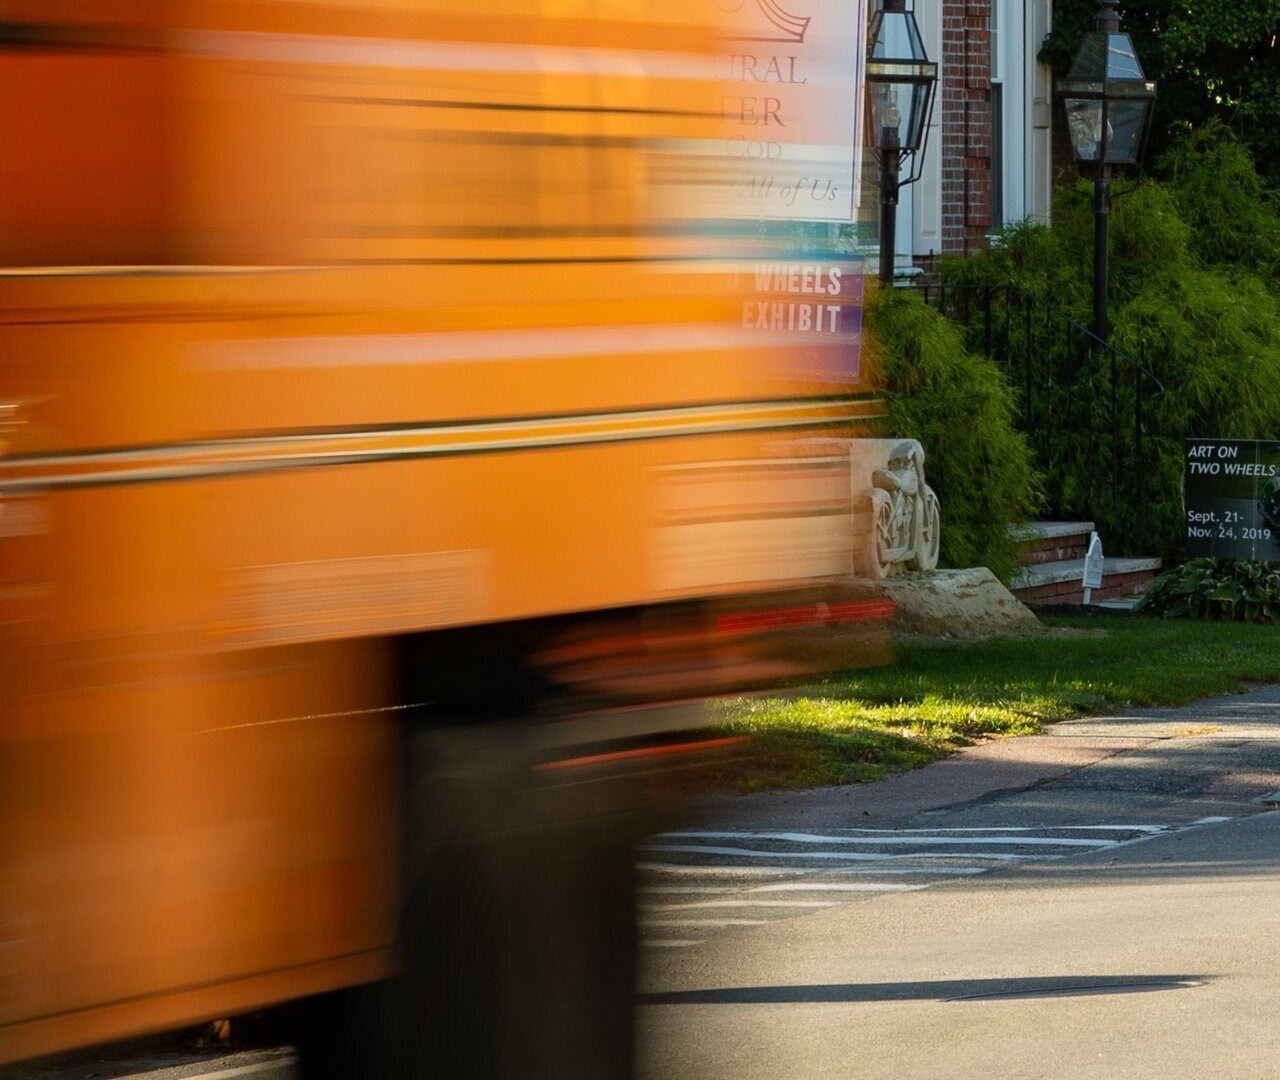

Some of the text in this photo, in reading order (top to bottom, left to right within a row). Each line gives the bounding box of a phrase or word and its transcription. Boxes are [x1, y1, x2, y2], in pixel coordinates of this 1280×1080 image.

[712, 54, 807, 84] URAL
[719, 96, 786, 127] TER
[780, 177, 808, 206] of
[811, 179, 838, 201] Us
[754, 264, 842, 295] WHEELS
[742, 301, 841, 332] EXHIBIT
[1188, 446, 1238, 458] ART ON
[1189, 462, 1276, 476] TWO WHEELS
[1188, 510, 1244, 524] Sept. 21-
[1188, 527, 1271, 540] Nov. 24, 2019
